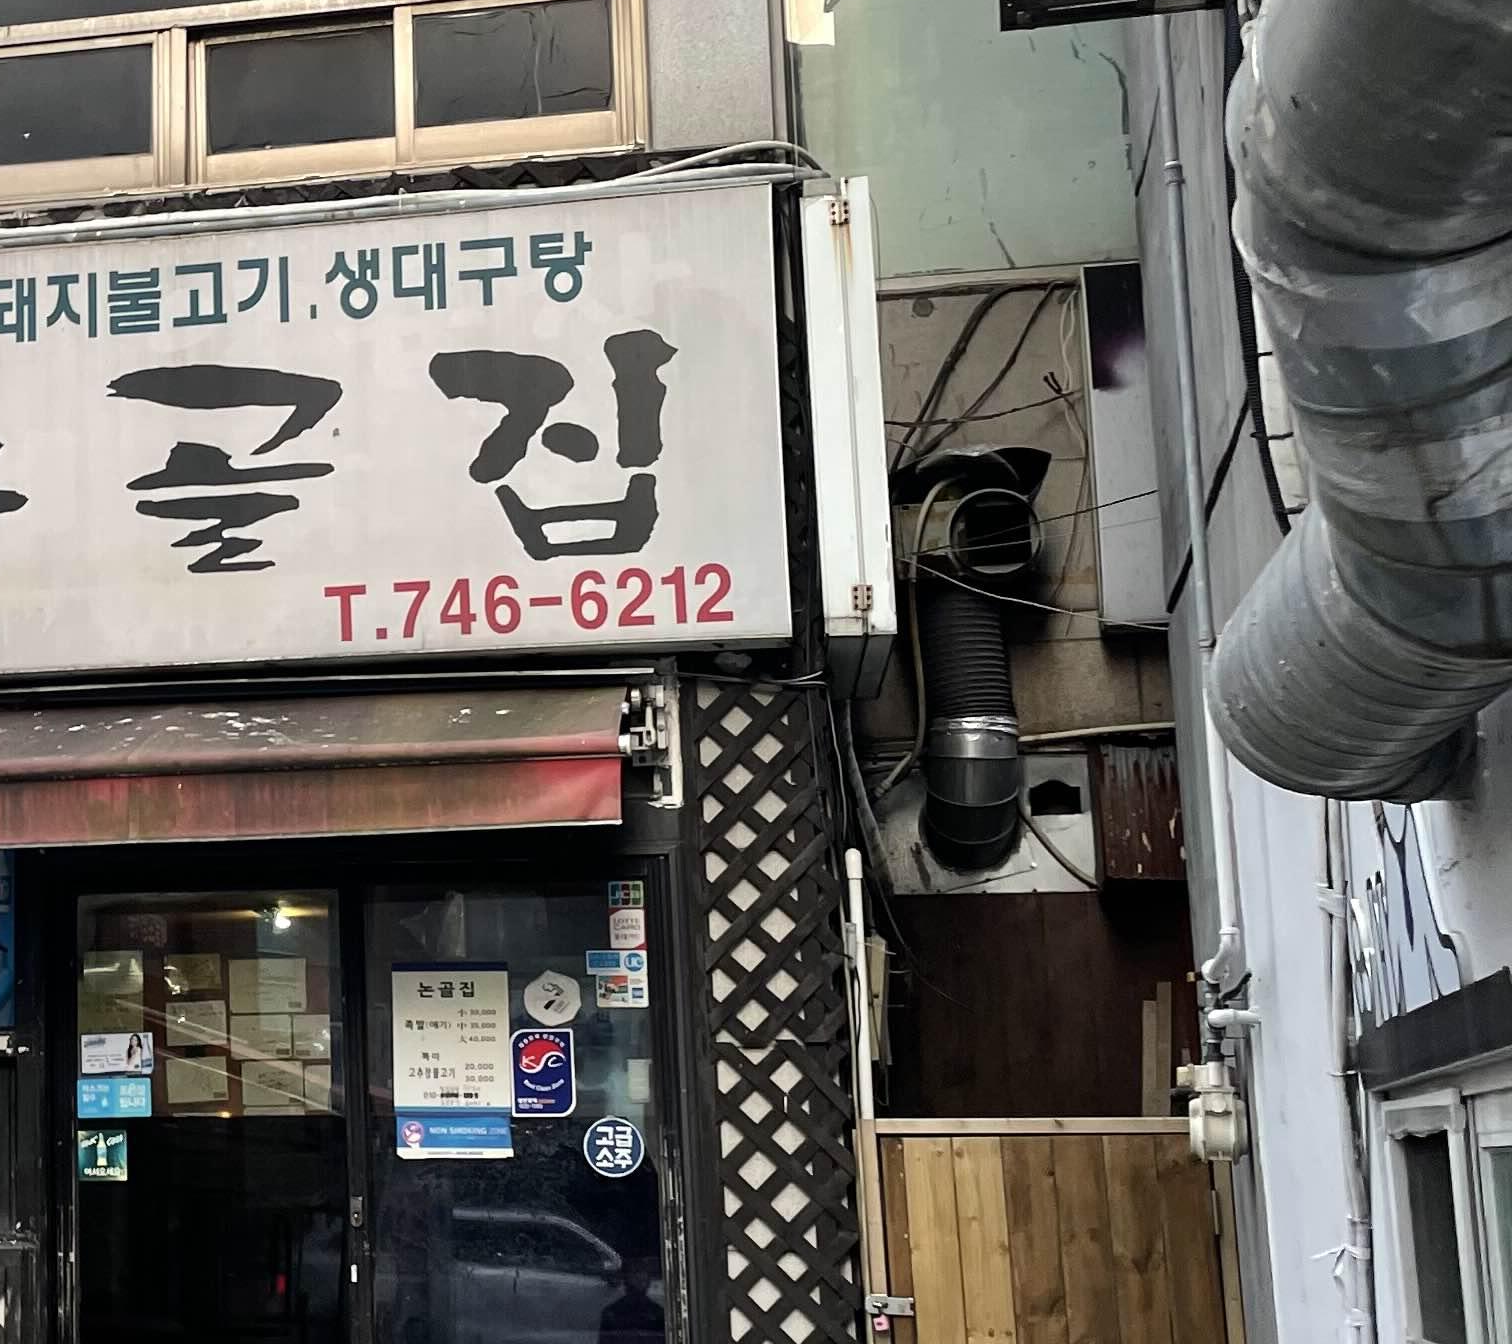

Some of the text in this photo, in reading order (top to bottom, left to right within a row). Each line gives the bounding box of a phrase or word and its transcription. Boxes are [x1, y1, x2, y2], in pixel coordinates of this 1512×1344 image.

[324, 562, 734, 643] T.746-6212
[417, 981, 475, 998] 논골집
[595, 1125, 633, 1147] 고급
[595, 1147, 633, 1169] 소주
